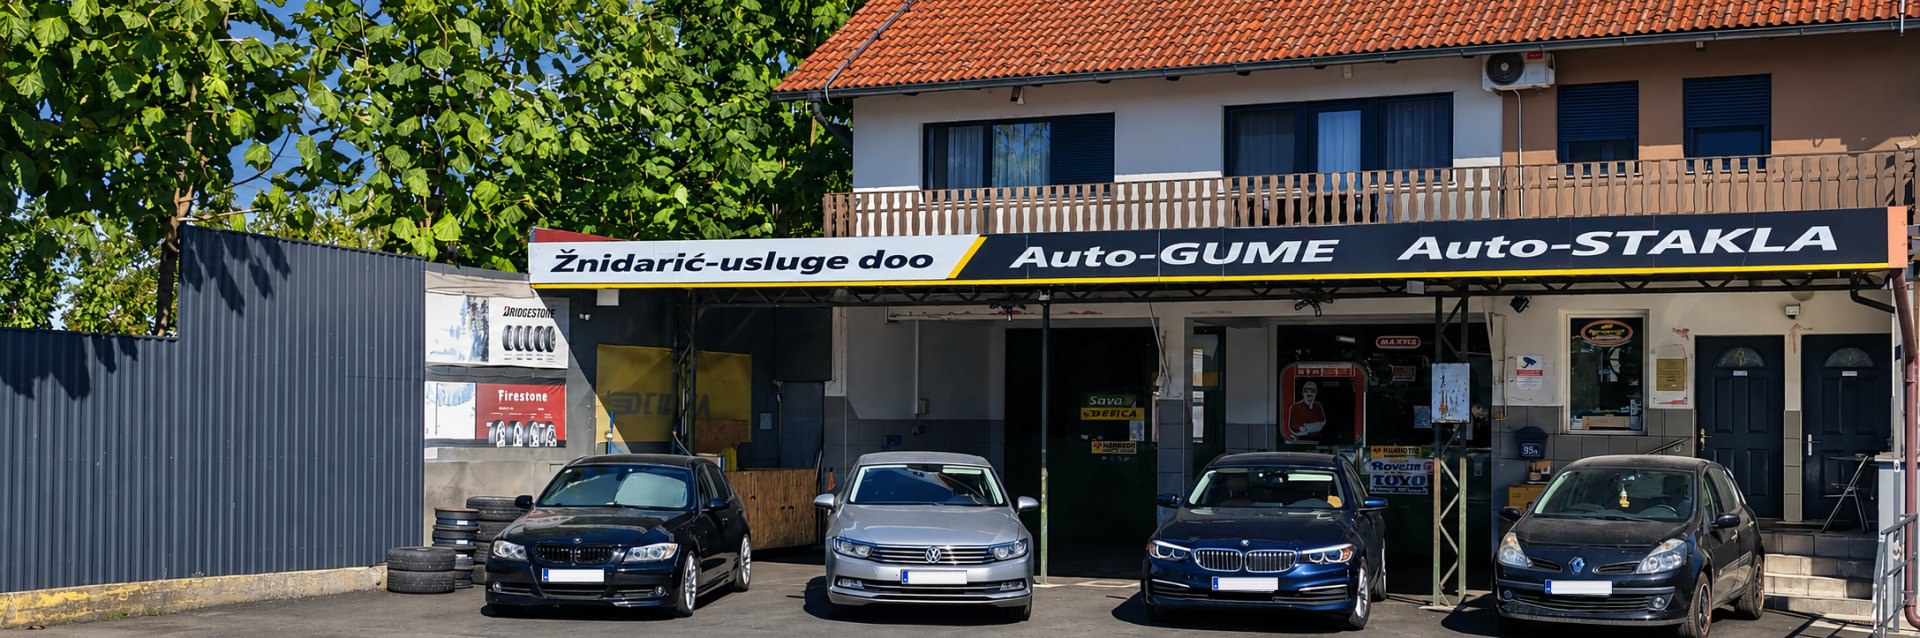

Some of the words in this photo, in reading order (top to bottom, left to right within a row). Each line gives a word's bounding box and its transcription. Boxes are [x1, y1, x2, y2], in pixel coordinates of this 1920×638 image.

[1397, 225, 1838, 262] Auto-STAKLA
[1009, 239, 1340, 269] Auto-GUME
[550, 248, 849, 276] Žnidarić-usluge
[858, 249, 934, 270] doo
[503, 305, 556, 319] BRIDGESTONE
[498, 389, 548, 403] Firestone
[1089, 395, 1122, 406] Sava
[1373, 475, 1426, 486] TOYO
